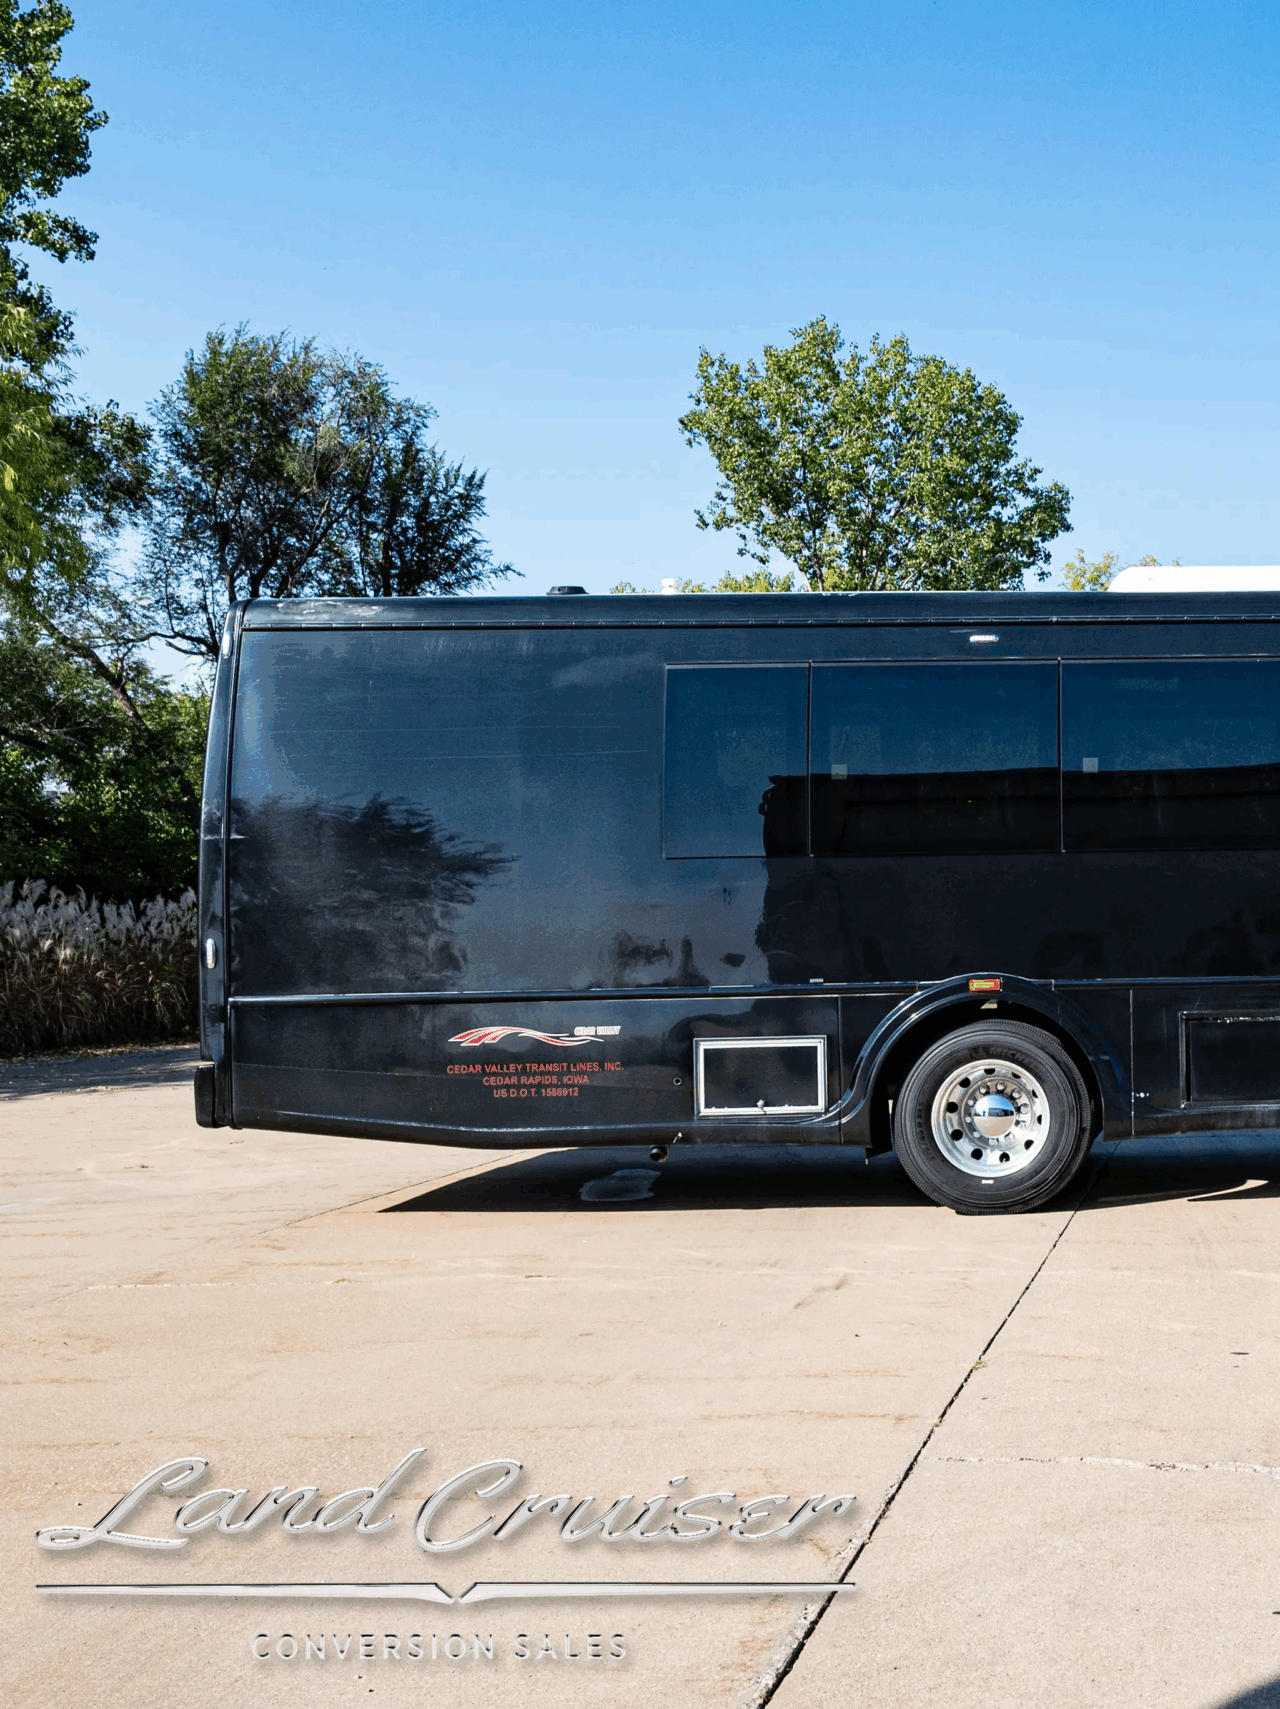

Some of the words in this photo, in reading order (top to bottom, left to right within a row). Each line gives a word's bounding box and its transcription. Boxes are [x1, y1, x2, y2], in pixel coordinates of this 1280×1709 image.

[447, 1064, 482, 1074] CEDAR
[484, 1064, 523, 1073] VALLEY
[525, 1063, 568, 1072] TRANSIT
[570, 1062, 602, 1072] LINES,
[604, 1061, 624, 1071] INC.
[482, 1076, 518, 1086] CEDAR
[520, 1075, 561, 1086] RAPIDS,
[563, 1074, 590, 1084] IOWA
[493, 1088, 508, 1098] US
